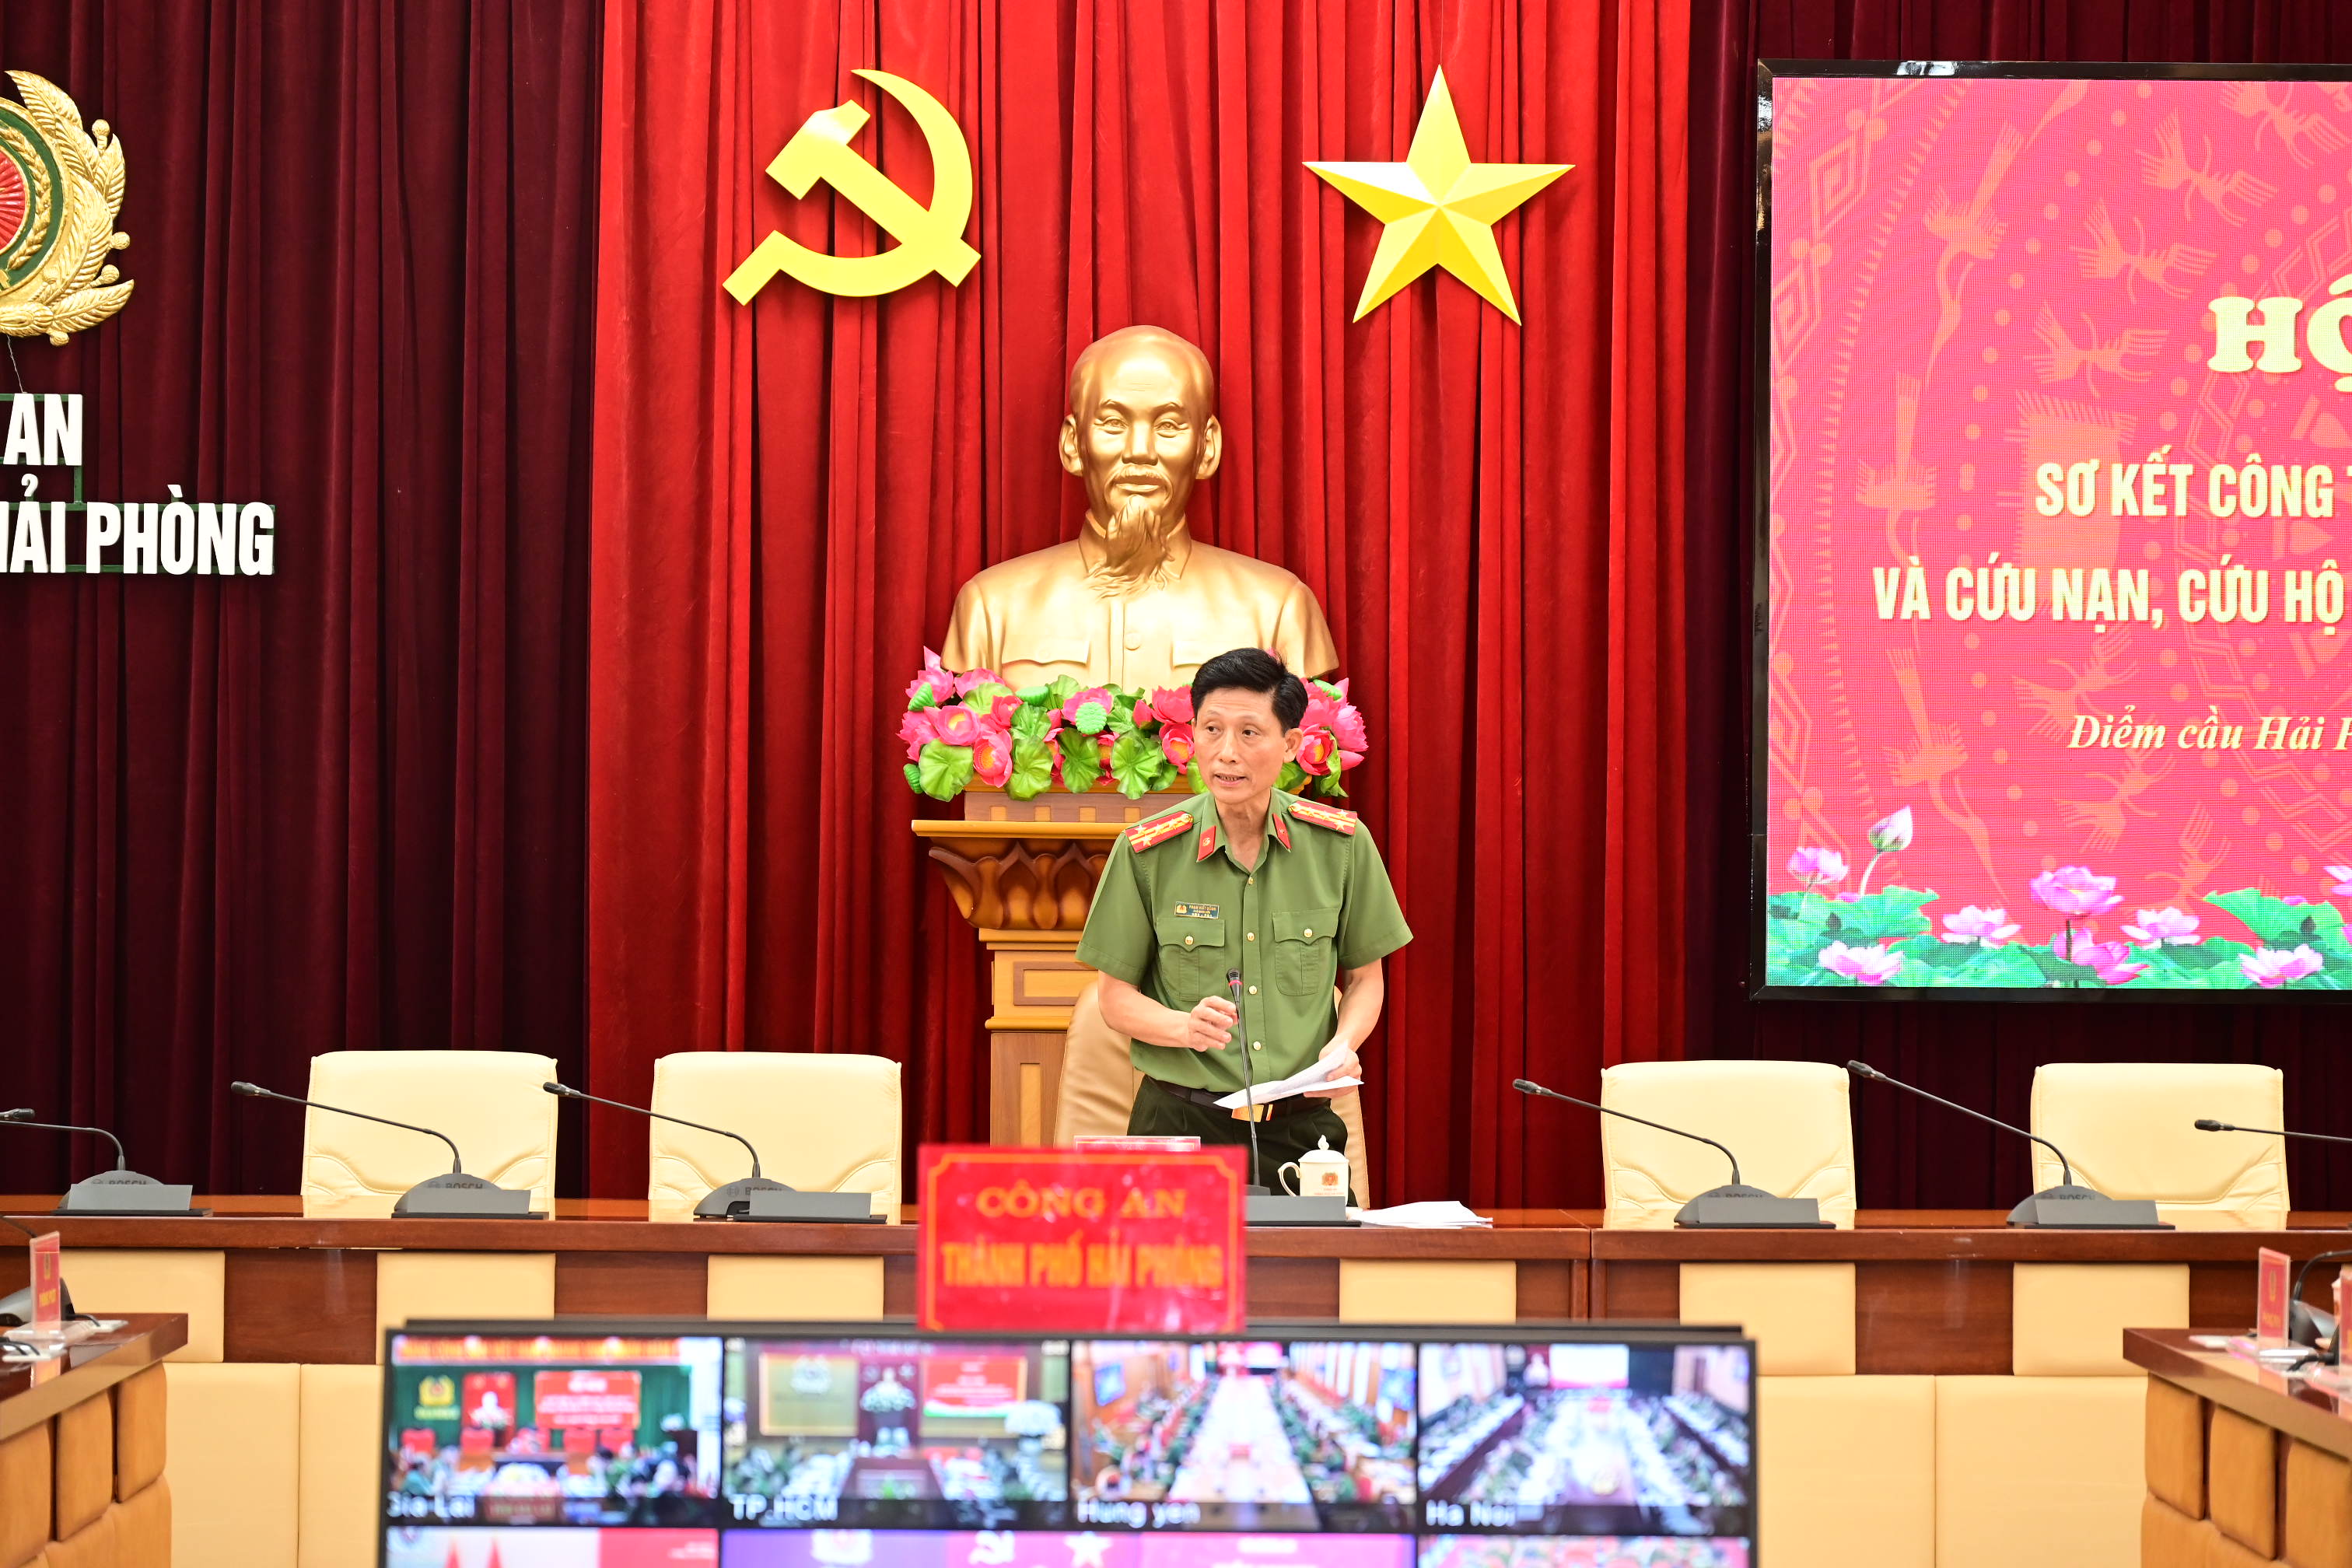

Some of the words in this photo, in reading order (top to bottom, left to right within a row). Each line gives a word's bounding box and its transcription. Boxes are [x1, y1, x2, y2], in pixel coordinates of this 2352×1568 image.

[2, 393, 83, 466] AN
[2035, 459, 2100, 516] SƠ
[2111, 445, 2193, 516] KẾT
[2209, 453, 2334, 518] CÔNG
[86, 485, 275, 576] PHÒNG
[1873, 557, 1931, 620] VÀ
[1945, 553, 2036, 621] CỨU
[2053, 569, 2165, 633] NẠN,
[2178, 554, 2270, 623] CỨU
[2284, 559, 2345, 636] HỘ
[2067, 705, 2166, 749] Điểm
[2177, 705, 2243, 749] cầu
[2254, 716, 2325, 751] Hải
[975, 1180, 1104, 1219] CÔNG
[1121, 1188, 1187, 1219] AN
